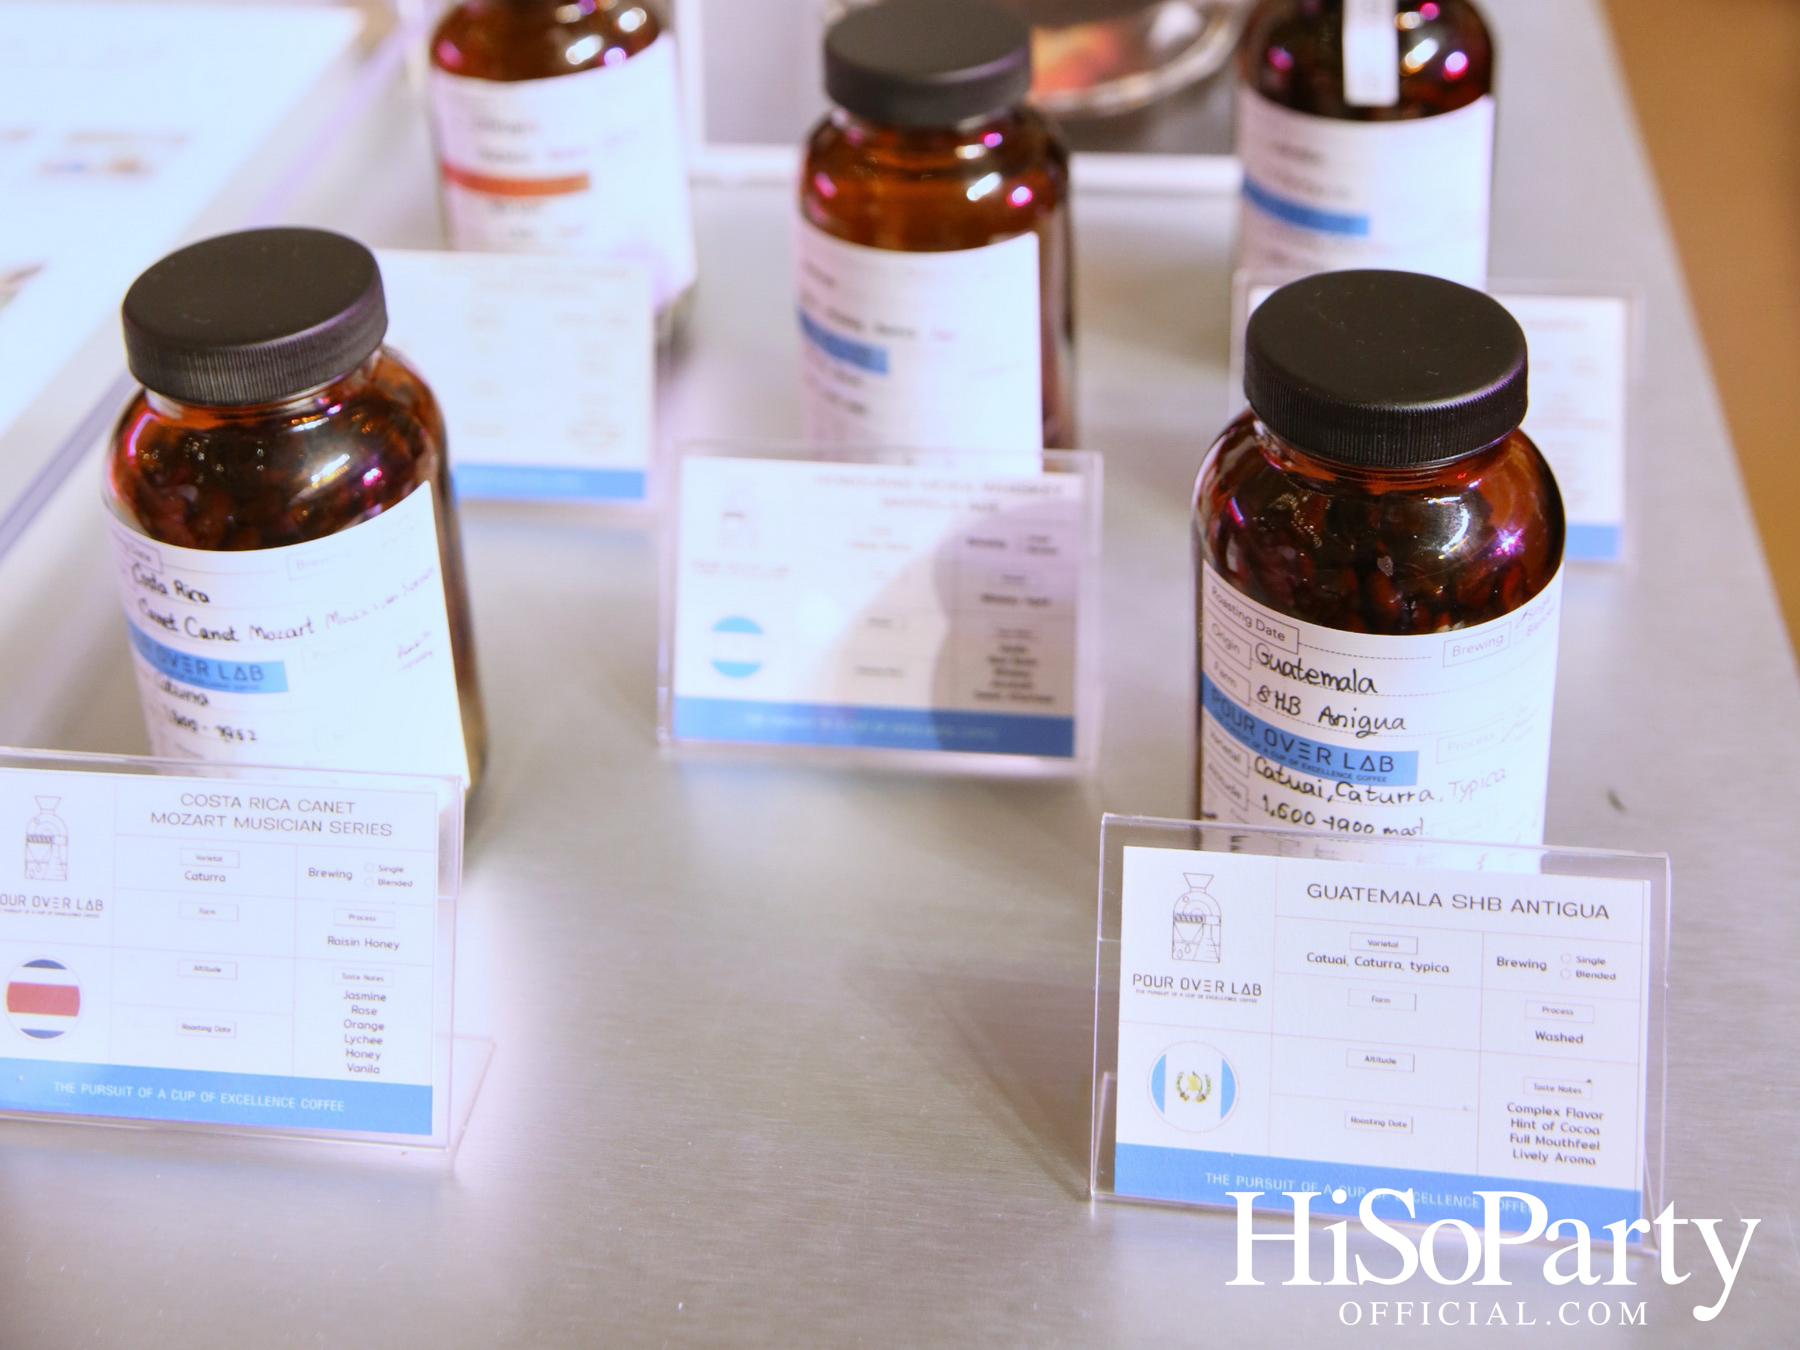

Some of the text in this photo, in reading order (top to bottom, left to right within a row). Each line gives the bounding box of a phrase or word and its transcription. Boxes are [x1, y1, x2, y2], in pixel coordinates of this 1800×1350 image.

[174, 580, 211, 603] Rica
[184, 616, 240, 642] Canet
[249, 615, 315, 642] Mozart
[1256, 617, 1286, 642] Date
[1452, 634, 1505, 658] Brewing
[217, 664, 264, 681] LAB
[1255, 641, 1379, 694] Guatemala
[1264, 728, 1332, 766] OVER
[1344, 752, 1395, 773] LAB
[1301, 762, 1353, 781] EXCELLENCE
[1356, 774, 1388, 783] COFFEE
[1448, 768, 1508, 804] Typica
[180, 792, 357, 814] COSTA RICA CANET
[150, 812, 393, 837] MOZART MUSICIAN SERIES
[184, 870, 227, 883] Caturra
[308, 866, 353, 881] Brewing
[377, 863, 405, 874] Single
[377, 878, 414, 888] Blended
[0, 893, 104, 911] OUR OVER LAB
[1306, 882, 1610, 920] GUATEMALA SHB ANTIGUA
[348, 913, 378, 923] Process
[327, 935, 401, 951] Raisin Honey
[1367, 938, 1399, 949] Varietal
[1410, 960, 1450, 976] typica
[1496, 955, 1547, 972] Brewing
[1575, 954, 1607, 967] Single
[1575, 968, 1617, 981] Blended
[1132, 972, 1262, 997] POUR OVER LAB
[343, 990, 387, 1002] Jasmine
[1371, 995, 1391, 1005] Farm
[351, 1004, 378, 1016] Rose
[1542, 1005, 1575, 1017] Process
[343, 1019, 385, 1033] Orange
[344, 1033, 384, 1046] Lychee
[1535, 1029, 1585, 1045] Washed
[345, 1047, 382, 1061] Honey
[1364, 1054, 1397, 1066] Altitude
[346, 1061, 381, 1075] Vanila
[53, 1080, 345, 1113] THE PURSUIT OF A CUP OF EXCELLENCE COFFEE
[1533, 1081, 1583, 1096] Taste Notes
[1507, 1101, 1605, 1121] Complex Flavor
[1350, 1115, 1408, 1130] Roasting Date
[1510, 1117, 1601, 1136] Hint of Cocoa
[1510, 1132, 1601, 1151] Full Mouthfeel
[1512, 1147, 1597, 1167] Lively Aroma
[1204, 1171, 1230, 1187] THE
[1236, 1174, 1296, 1192] PURSUIT
[1301, 1180, 1318, 1194] OF
[1323, 1183, 1334, 1196] A
